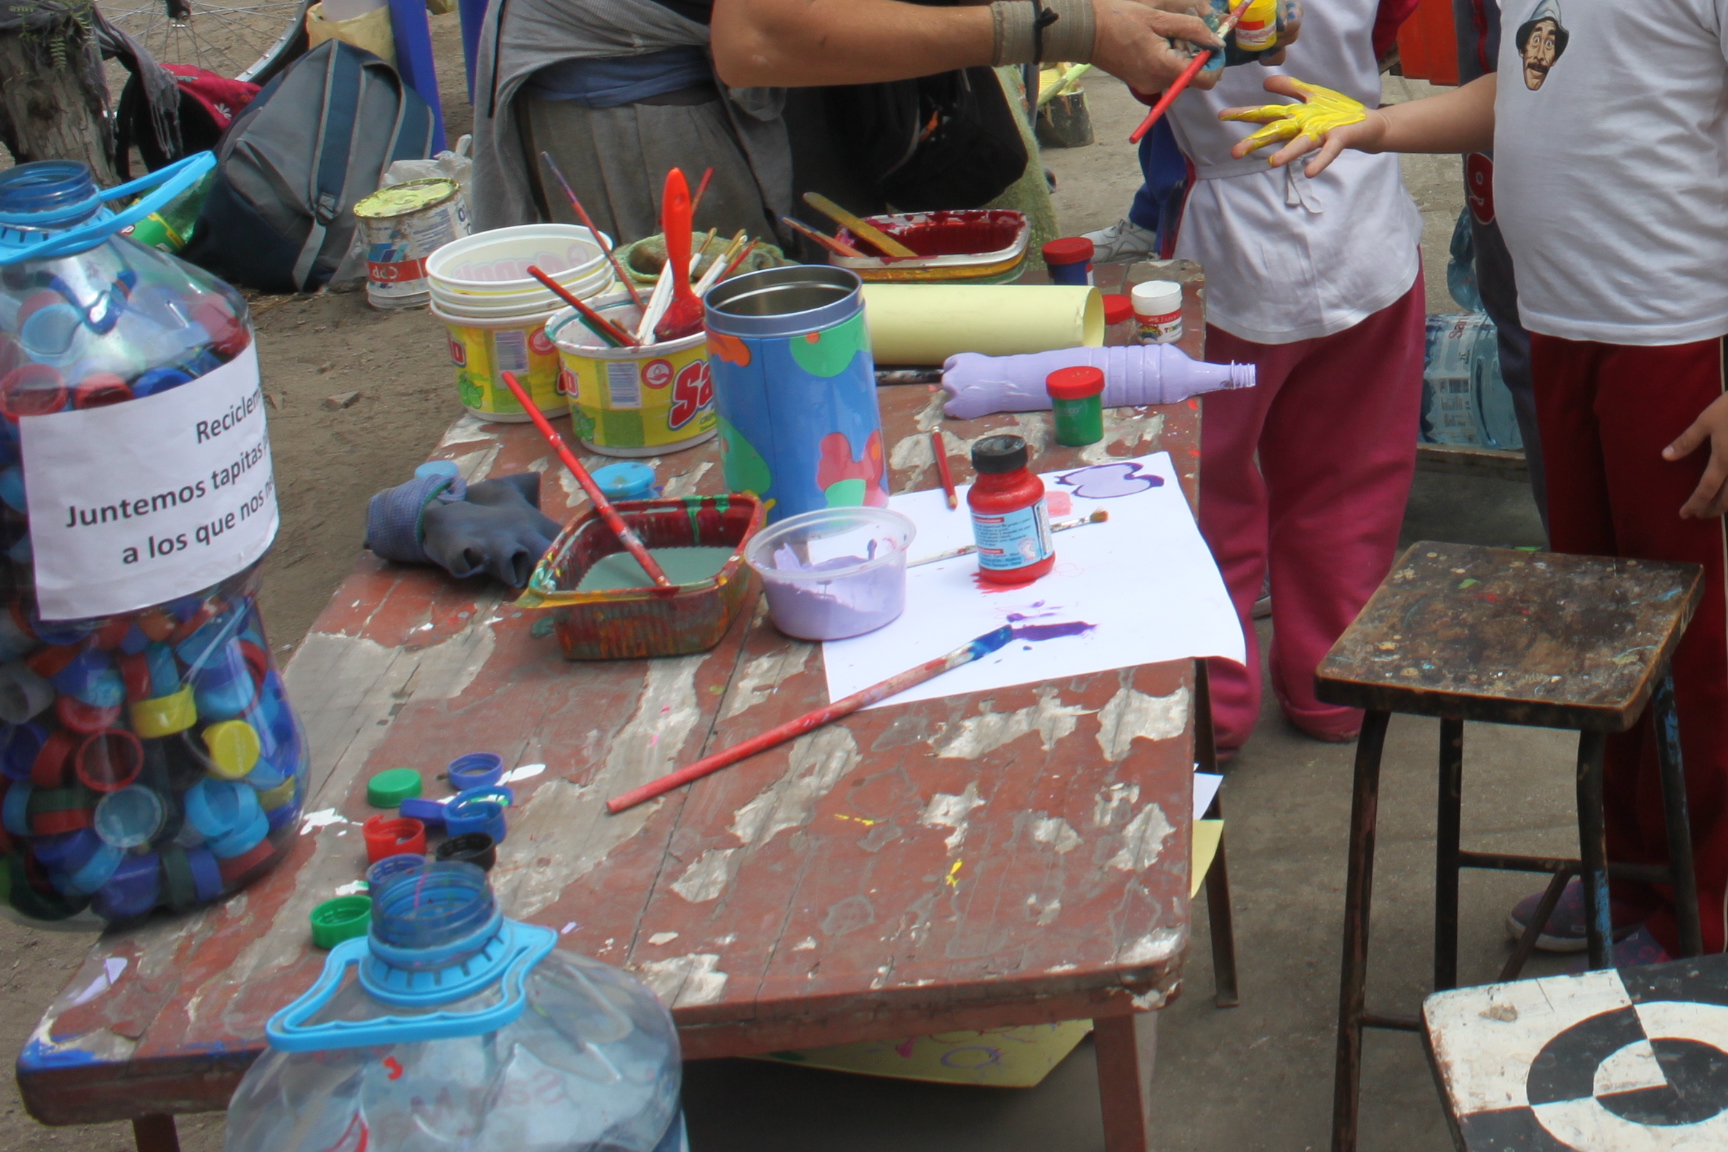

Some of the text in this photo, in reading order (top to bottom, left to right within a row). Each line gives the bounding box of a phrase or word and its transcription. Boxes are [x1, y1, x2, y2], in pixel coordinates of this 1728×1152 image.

[66, 479, 206, 529] Juntemos
[211, 441, 264, 491] tapitas
[122, 546, 139, 565] a
[149, 532, 188, 559] los
[195, 511, 236, 546] que
[240, 491, 265, 522] nos
